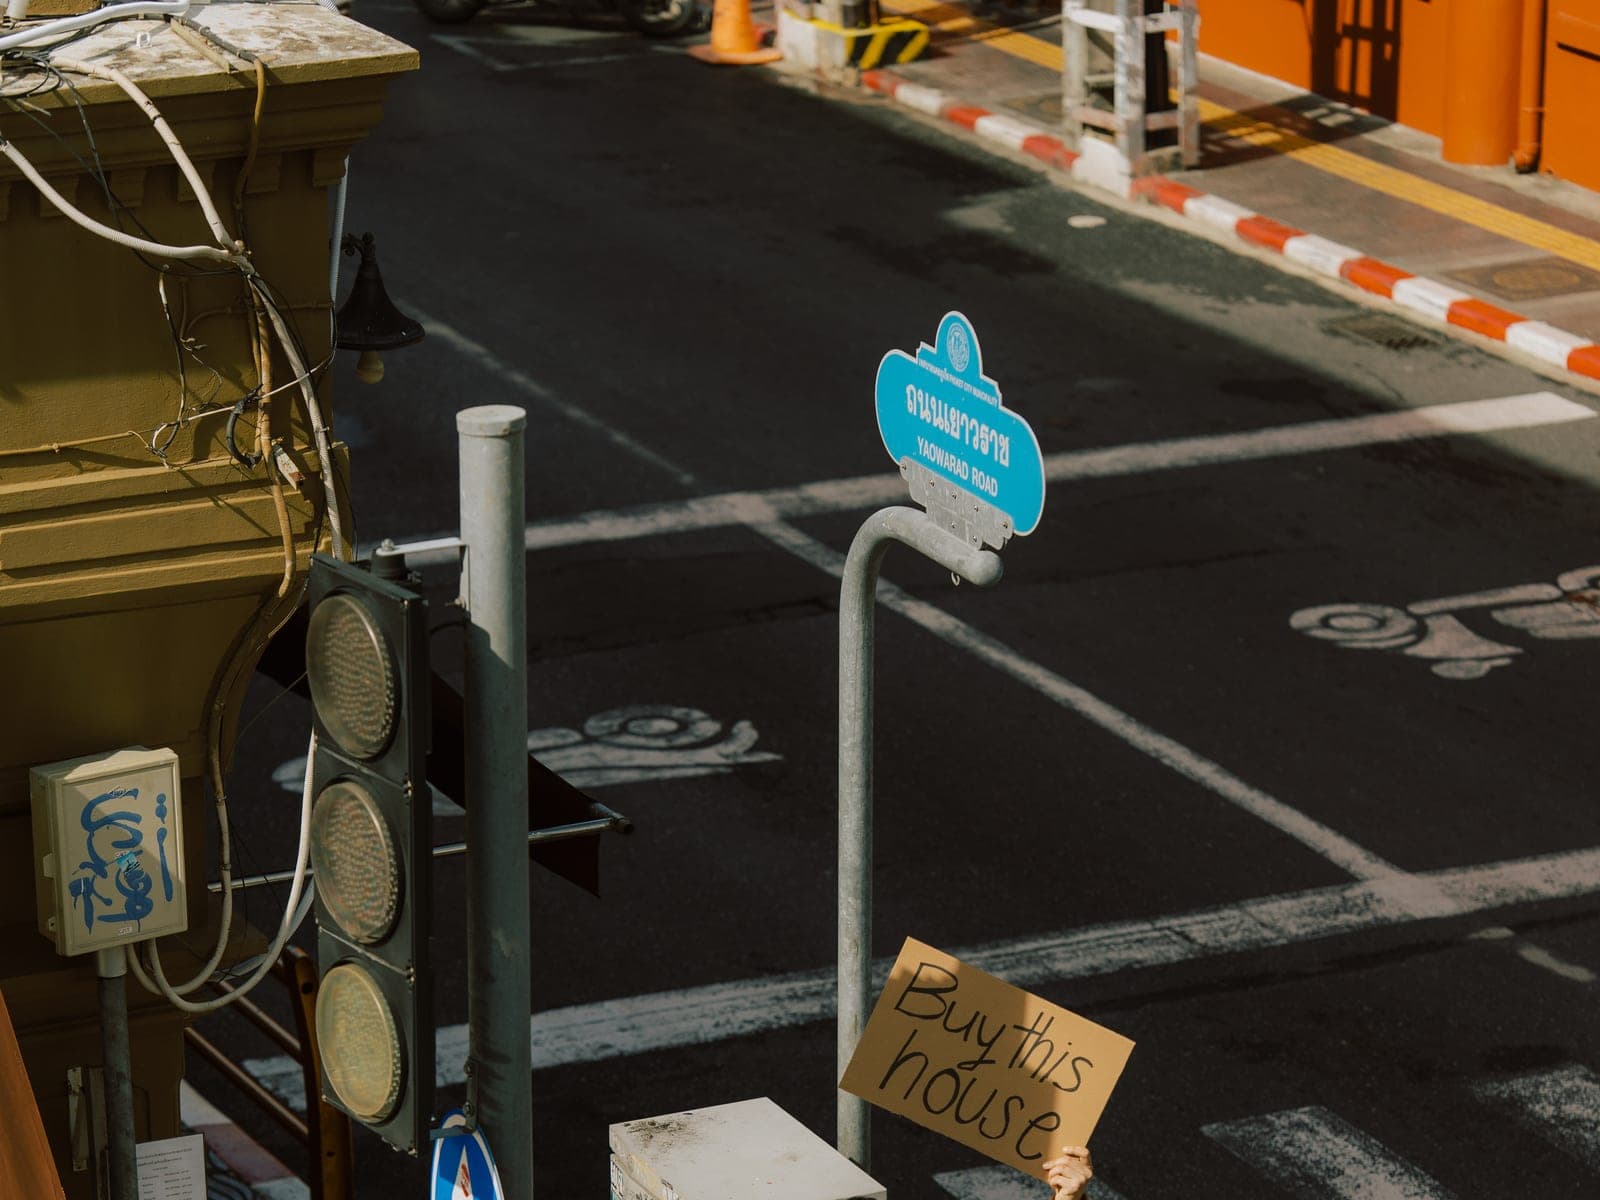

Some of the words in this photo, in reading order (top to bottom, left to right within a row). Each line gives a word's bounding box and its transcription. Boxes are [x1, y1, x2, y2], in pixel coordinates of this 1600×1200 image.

[906, 384, 1010, 468] ถนนเยาวราช
[917, 435, 969, 481] YAOWARAD
[971, 466, 999, 498] ROAD
[894, 962, 1006, 1071] Buy
[1008, 1012, 1094, 1093] this
[878, 1029, 1061, 1160] house
